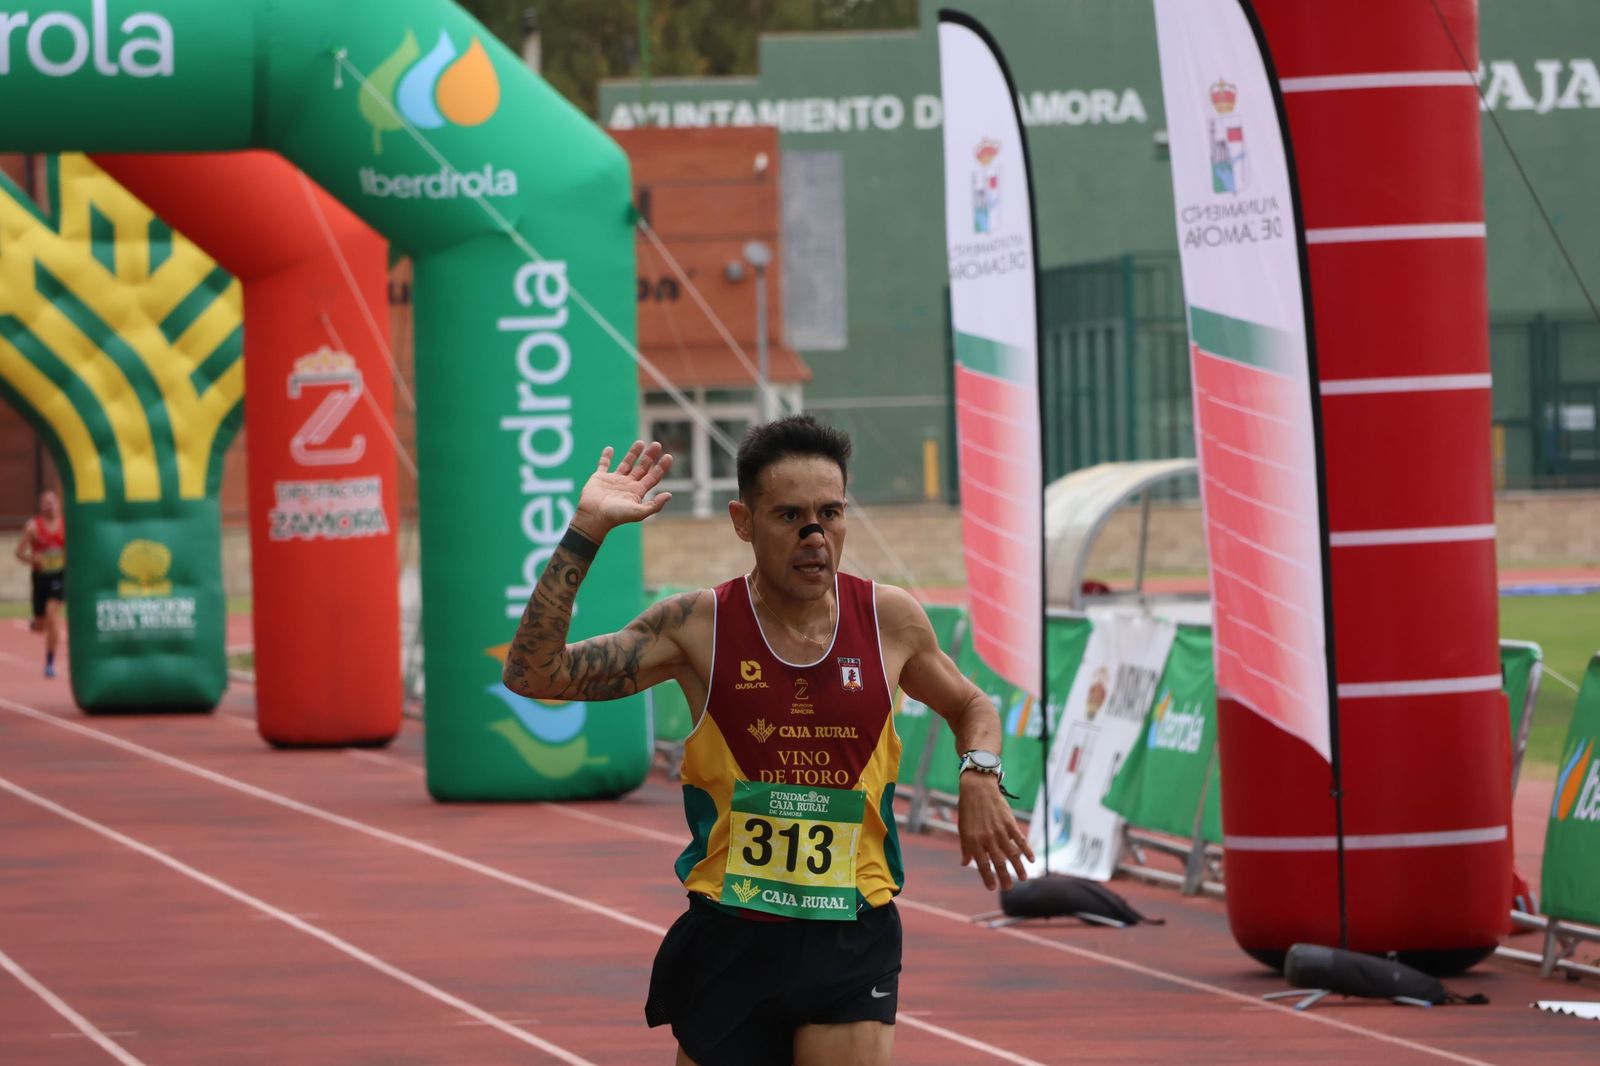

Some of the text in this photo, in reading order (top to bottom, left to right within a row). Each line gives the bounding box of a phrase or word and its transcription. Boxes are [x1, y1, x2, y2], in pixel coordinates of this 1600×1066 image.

[1479, 59, 1600, 114] AJA
[359, 163, 518, 199] Iberdrola
[735, 682, 770, 690] austral
[779, 726, 858, 738] CAJA RURAL
[777, 750, 830, 766] VINO
[759, 769, 849, 785] DE TORO
[770, 800, 828, 812] CAJA RURAL
[742, 818, 834, 875] 313
[762, 889, 849, 910] CAJA RURAL
